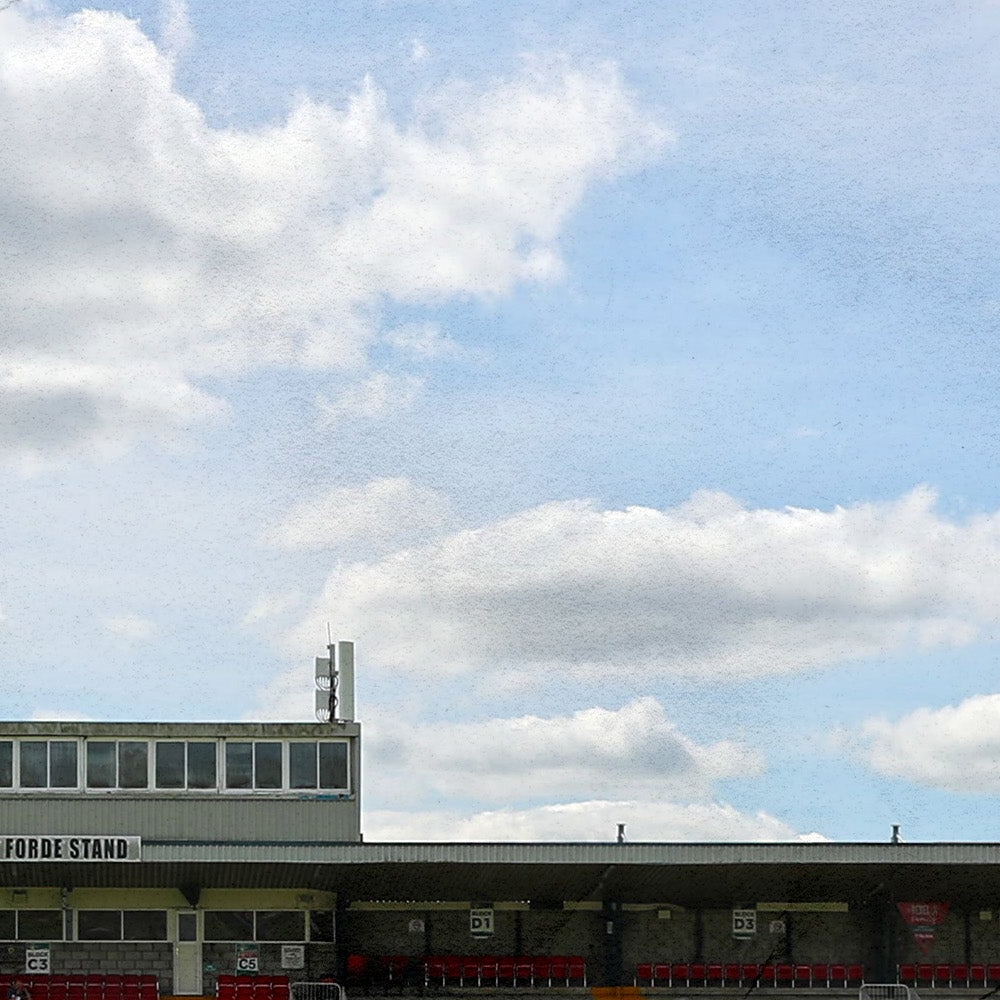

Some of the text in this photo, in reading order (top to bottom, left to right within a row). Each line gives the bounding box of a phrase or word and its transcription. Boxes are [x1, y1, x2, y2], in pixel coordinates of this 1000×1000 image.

[5, 838, 63, 858] FORDE
[69, 839, 128, 859] STAND
[471, 917, 490, 929] D1
[734, 918, 754, 930] D3
[27, 958, 48, 970] C3
[239, 958, 256, 969] C5
